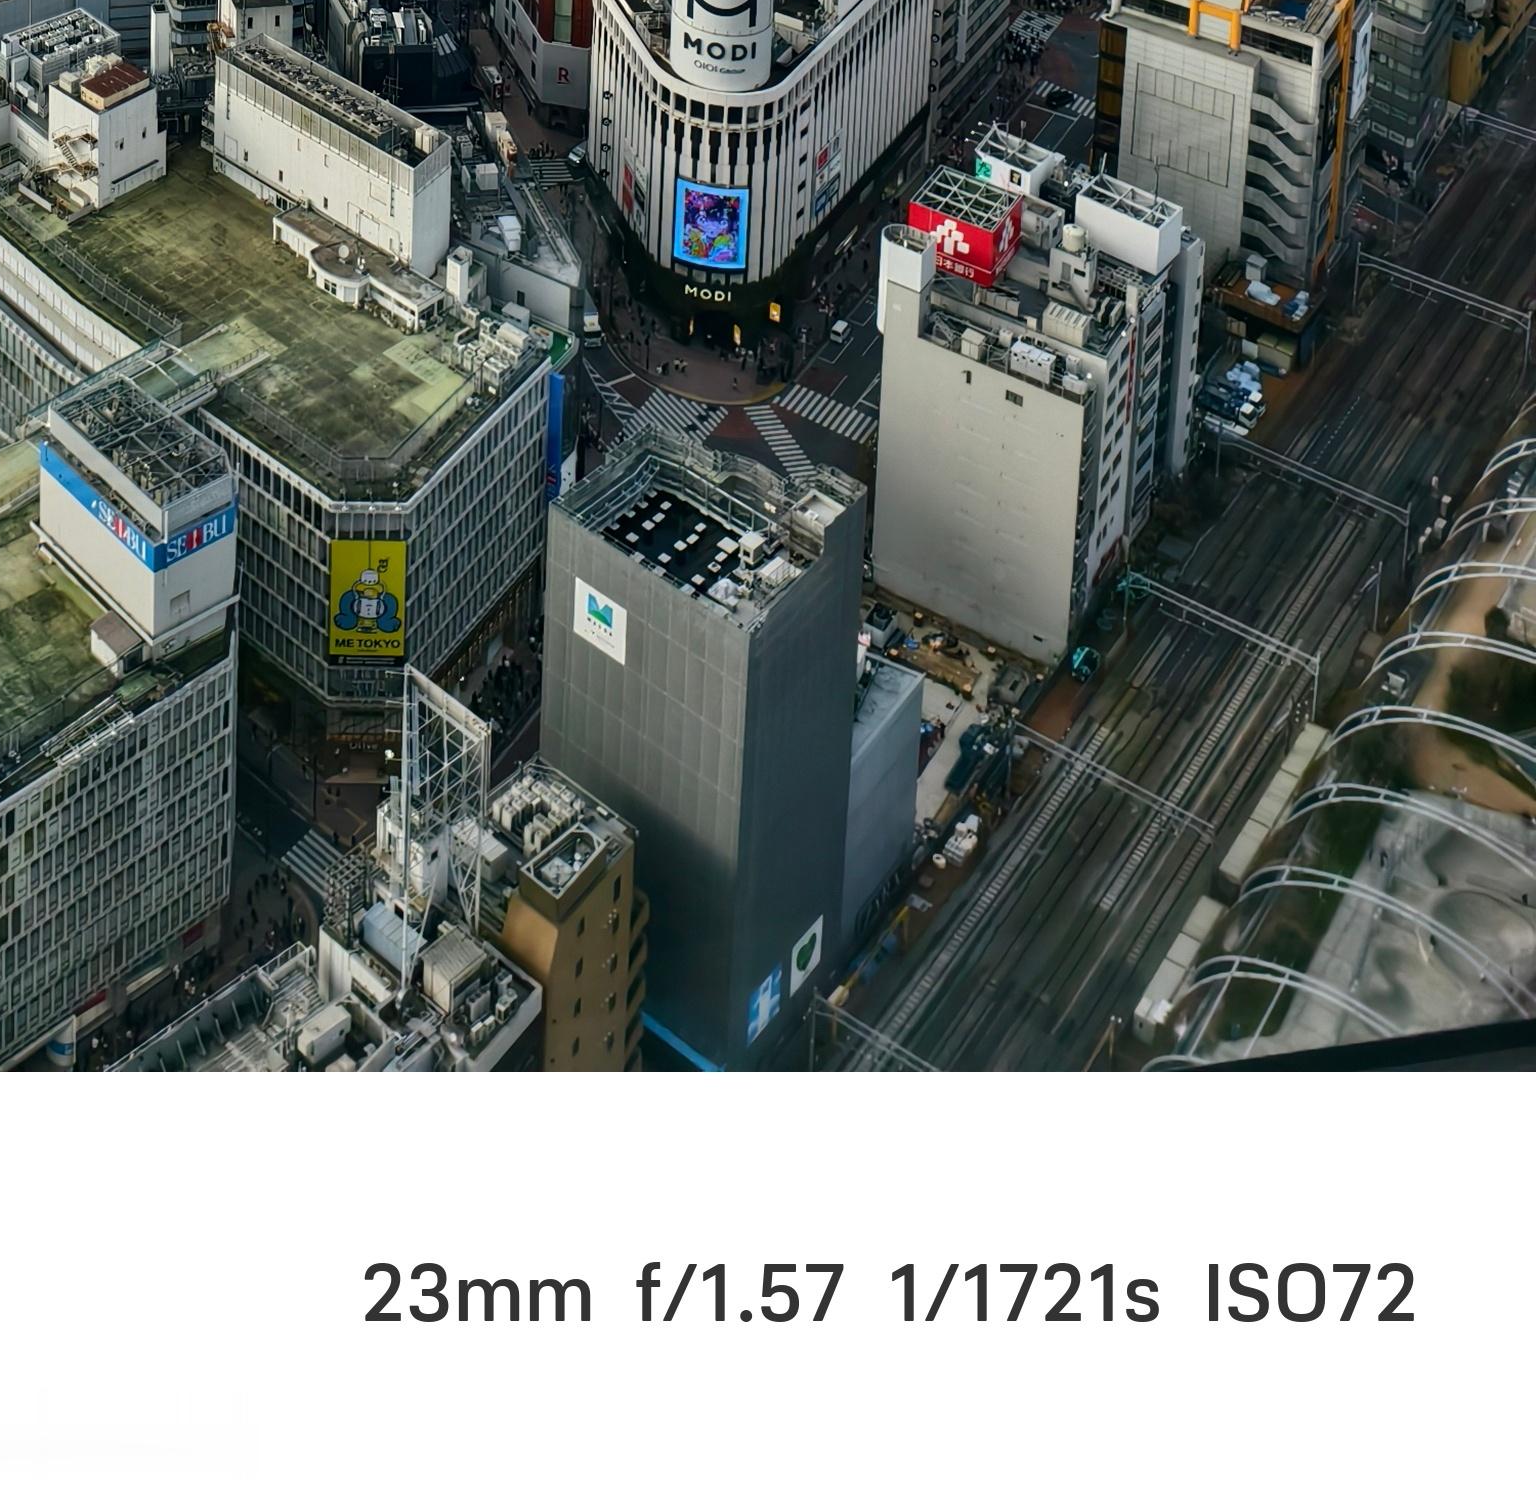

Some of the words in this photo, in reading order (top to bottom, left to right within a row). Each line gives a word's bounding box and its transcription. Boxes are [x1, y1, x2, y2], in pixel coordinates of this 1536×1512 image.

[683, 31, 757, 62] MODI
[684, 284, 732, 302] MODI
[98, 499, 147, 561] SEIBU
[166, 514, 227, 563] SEIBU
[334, 638, 354, 649] ME
[356, 638, 401, 650] TOKYO
